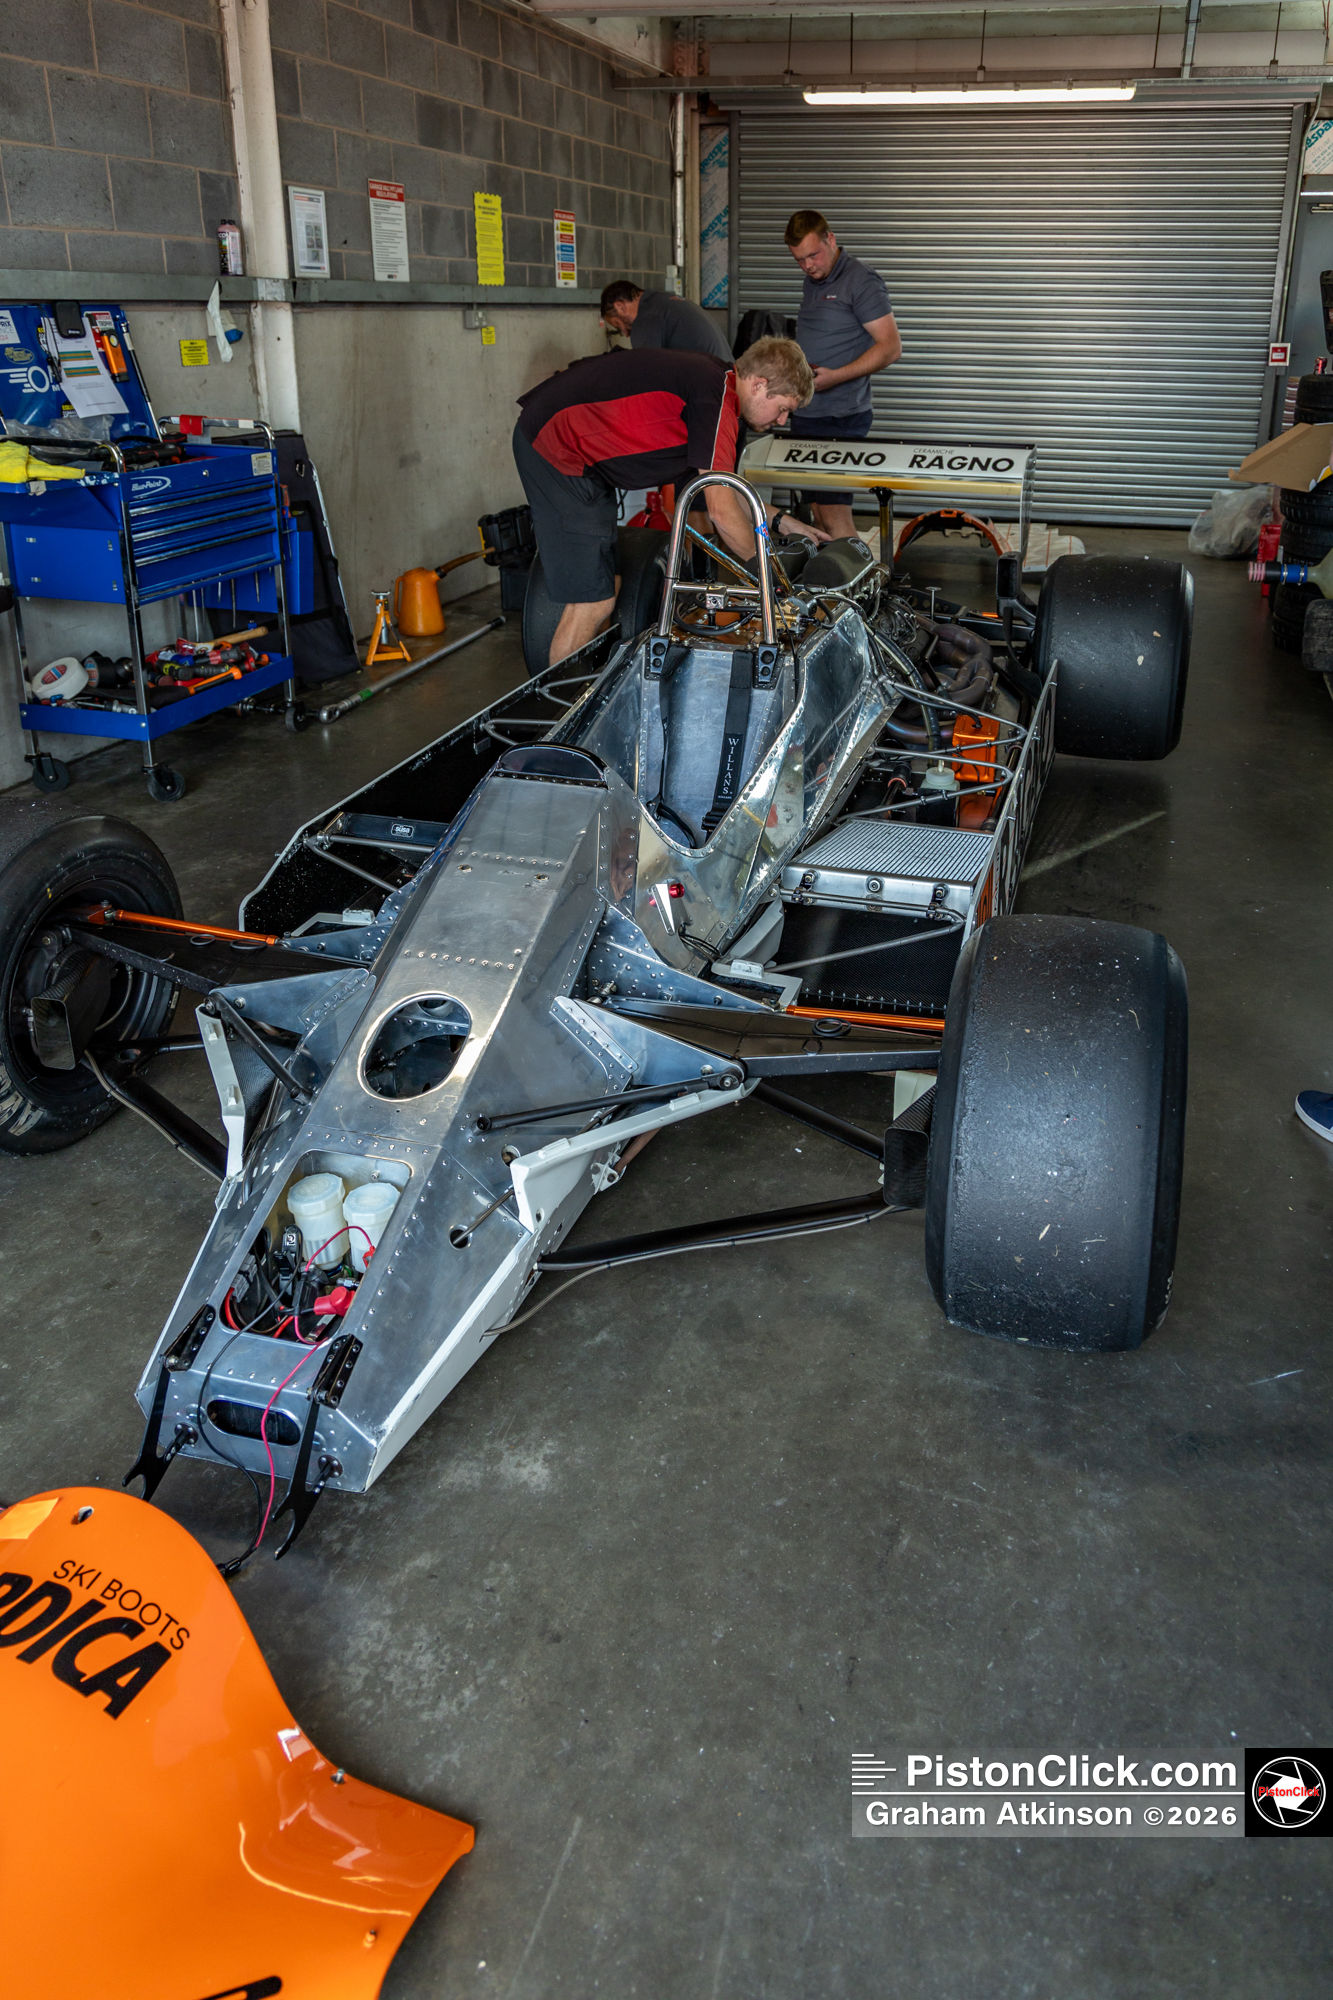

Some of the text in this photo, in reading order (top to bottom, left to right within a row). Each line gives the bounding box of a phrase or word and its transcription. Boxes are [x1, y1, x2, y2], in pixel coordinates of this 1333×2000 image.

[1305, 120, 1333, 151] gspa
[789, 442, 830, 450] CERAMICHE
[913, 447, 955, 455] CERAMICHE
[783, 448, 886, 467] RAGNO
[908, 454, 1015, 473] RAGNO
[53, 1560, 190, 1650] SKI BOOTS
